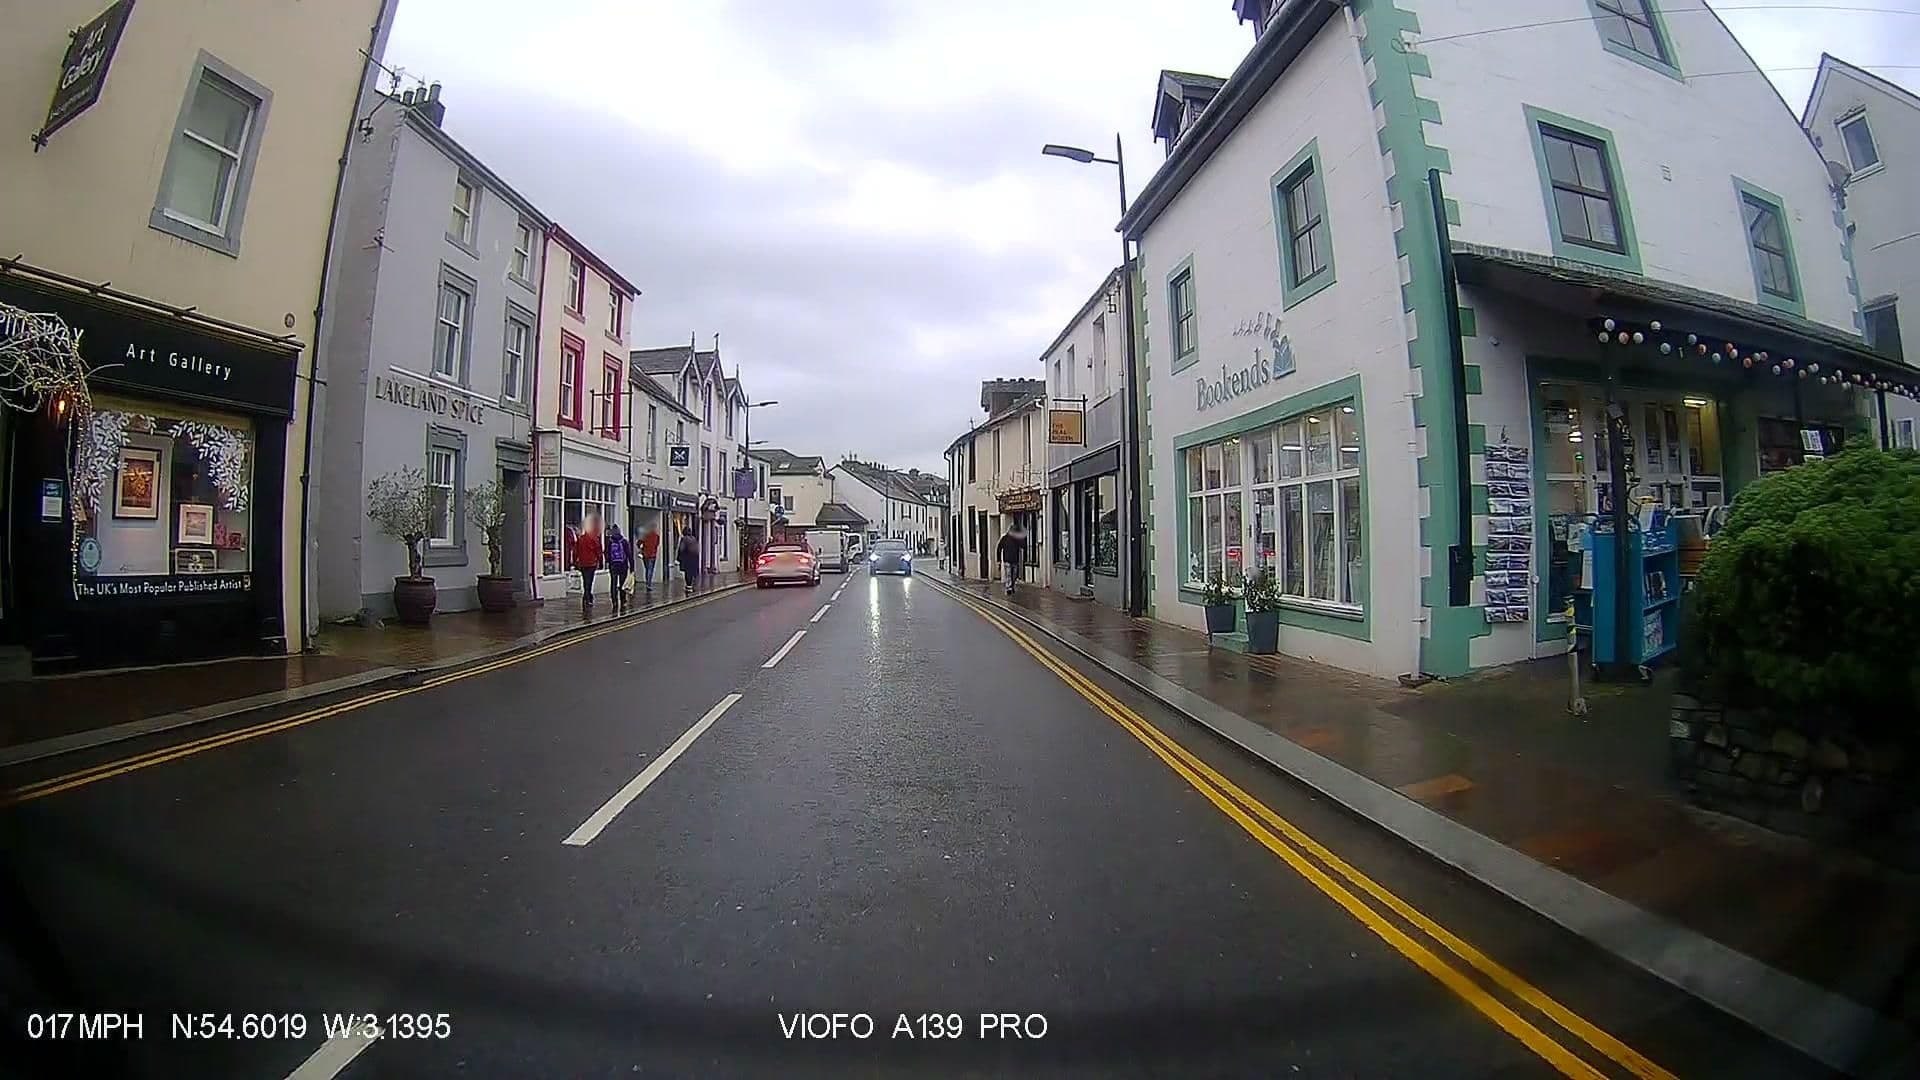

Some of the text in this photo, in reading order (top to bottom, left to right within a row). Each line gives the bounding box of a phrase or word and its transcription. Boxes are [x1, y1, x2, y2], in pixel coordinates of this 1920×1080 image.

[80, 21, 107, 56] Art
[61, 47, 106, 89] Gallery
[126, 343, 231, 381] Art Gallery
[1196, 347, 1270, 412] Bookends
[375, 376, 485, 425] LAKELAND SPICE
[77, 579, 242, 596] The UK's Most Popular Published Artist
